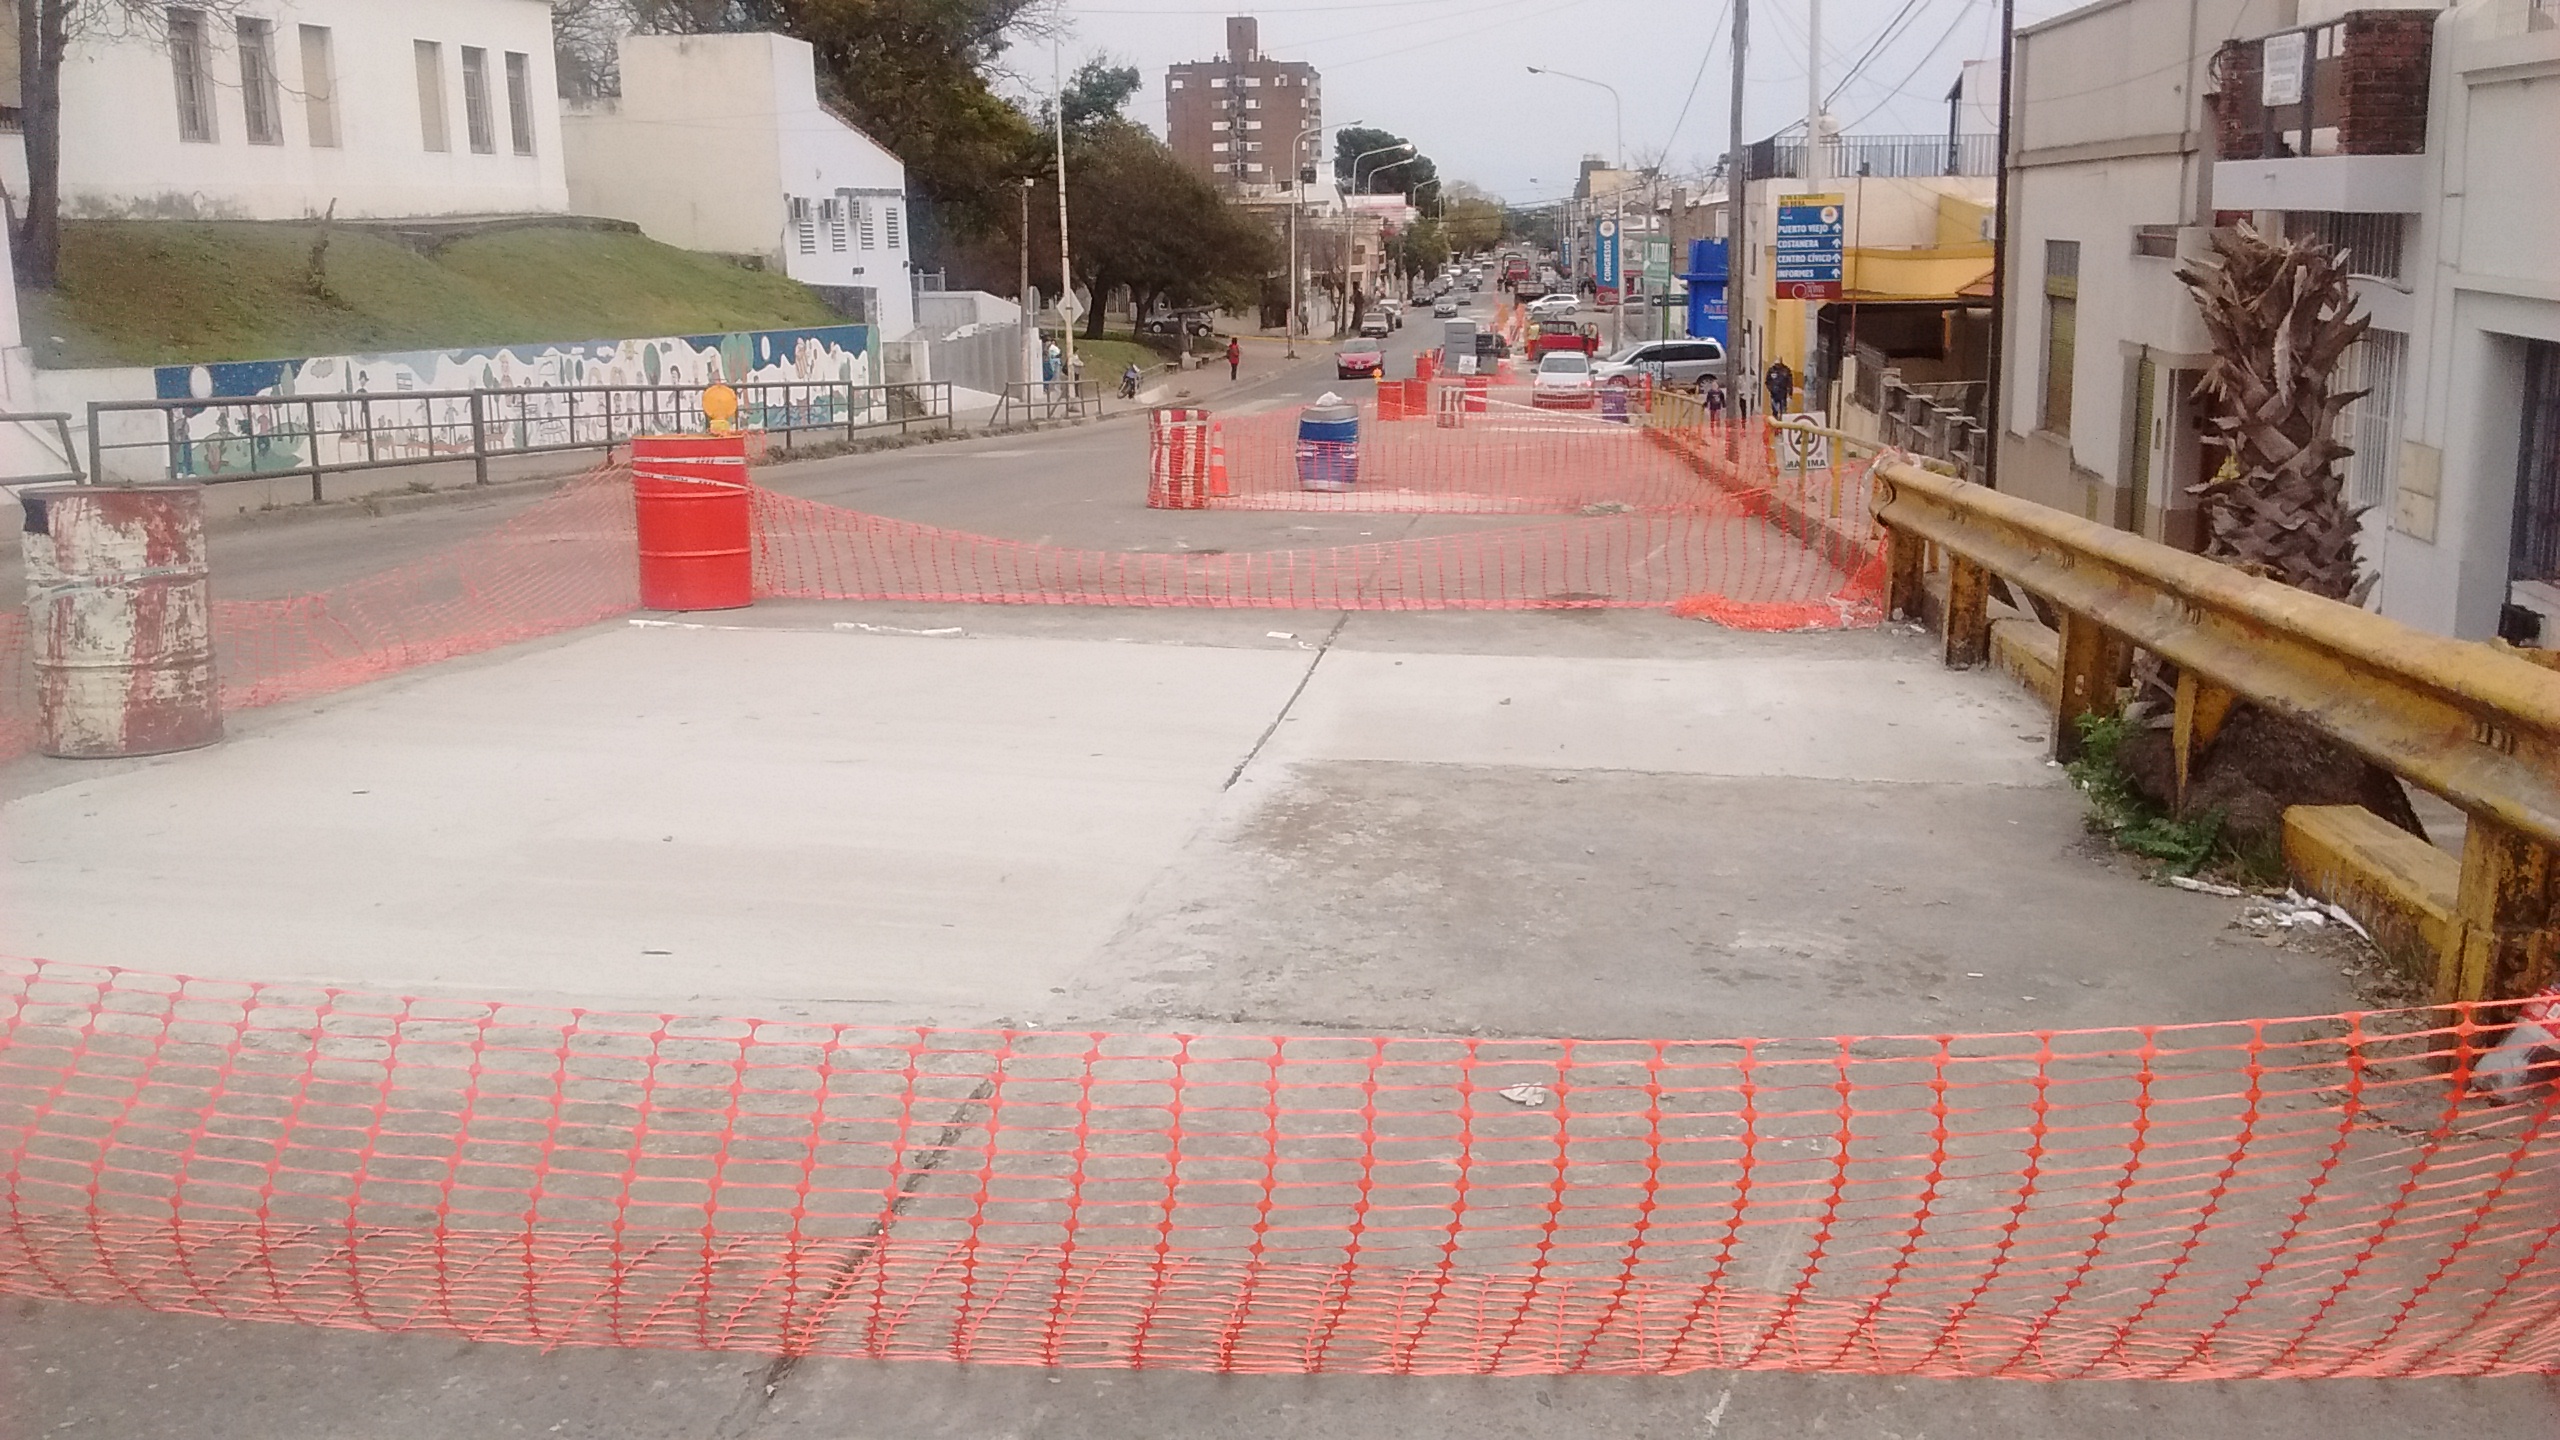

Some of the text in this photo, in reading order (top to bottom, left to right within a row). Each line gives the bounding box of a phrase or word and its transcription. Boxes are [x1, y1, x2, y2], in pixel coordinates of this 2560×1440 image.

[1777, 224, 1829, 234] PUERTO VIEJO
[1777, 240, 1819, 248] COSTANERA
[1603, 240, 1612, 281] CONGRESOS
[1777, 252, 1832, 263] CENTRO CÍVICO
[1777, 269, 1814, 278] INFORMES
[1786, 459, 1826, 468] MAIMA
